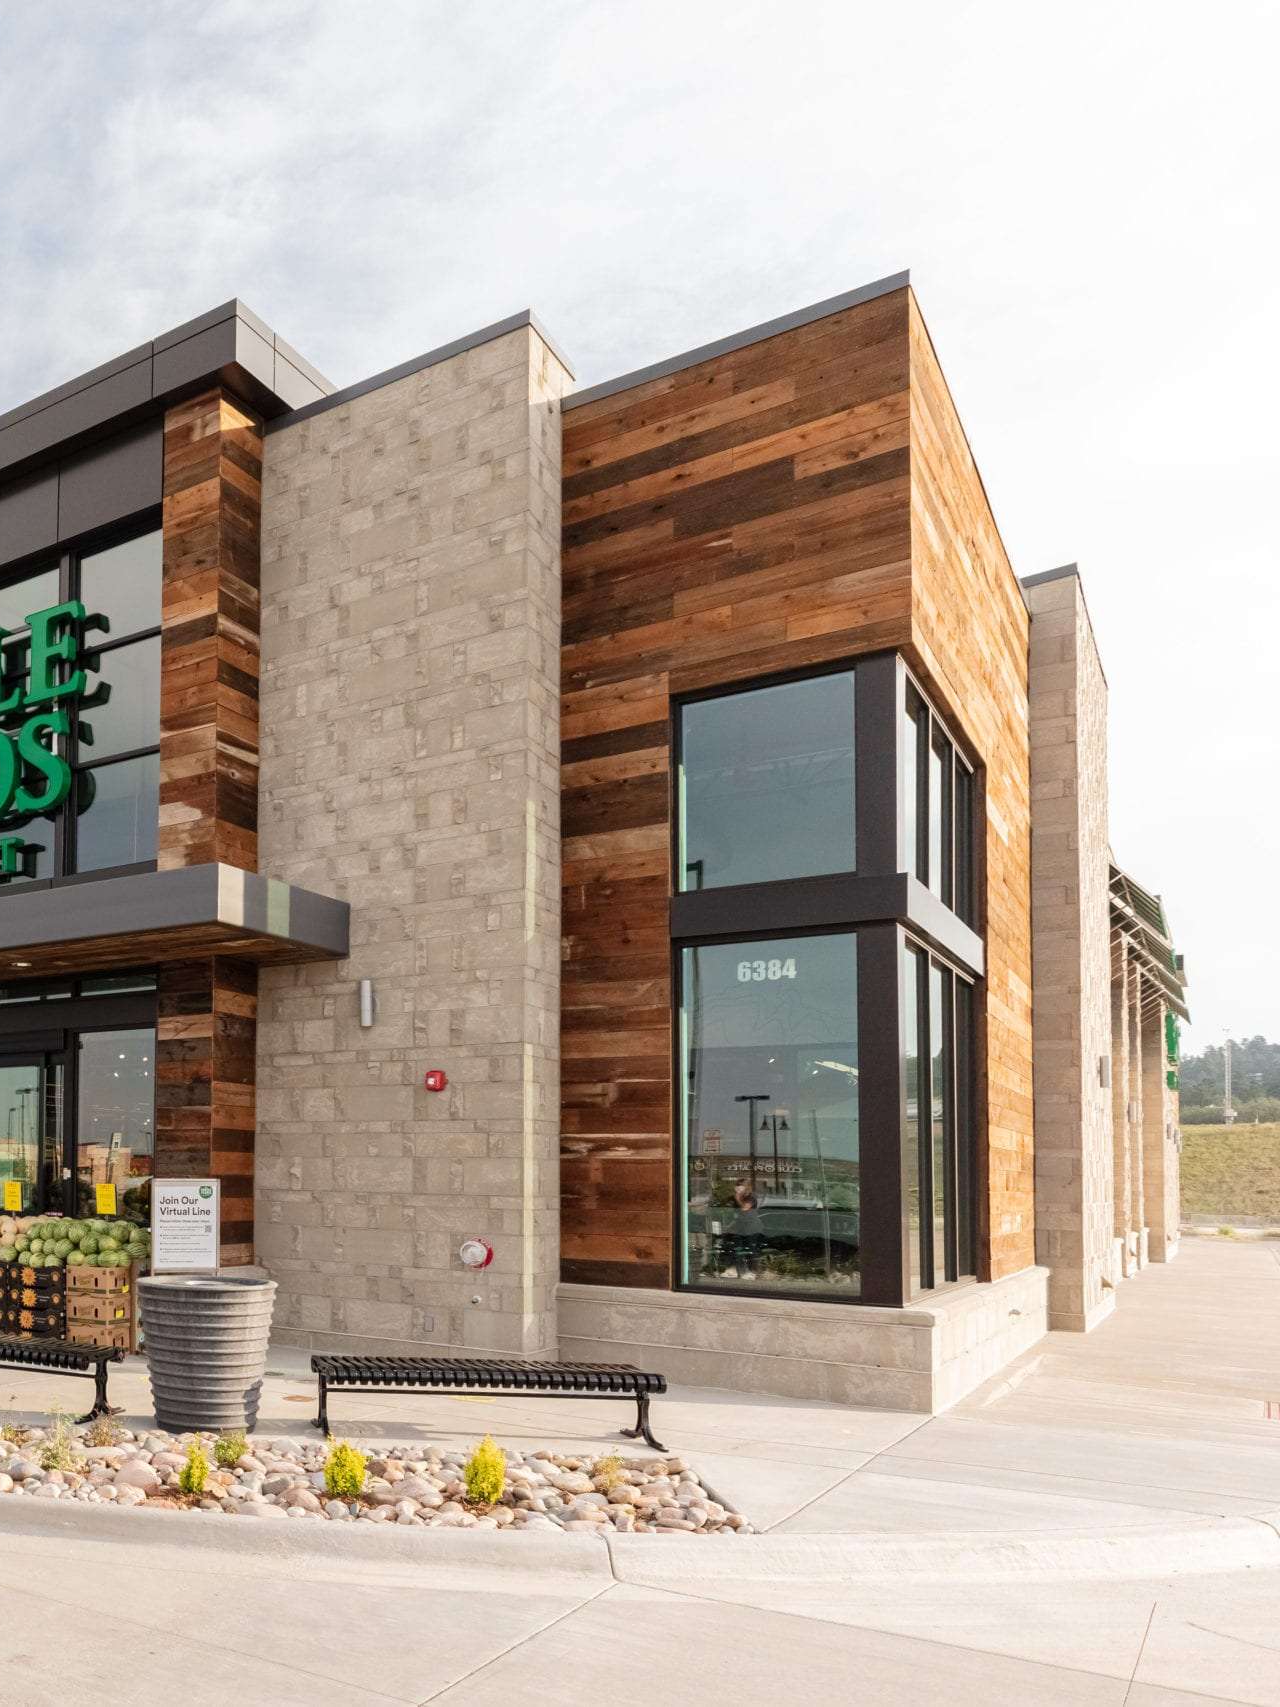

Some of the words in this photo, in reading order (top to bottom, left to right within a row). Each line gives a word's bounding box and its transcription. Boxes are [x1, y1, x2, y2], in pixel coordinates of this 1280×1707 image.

[737, 958, 797, 981] 6384
[160, 1196, 179, 1205] Join
[181, 1196, 199, 1205] Our
[160, 1207, 190, 1216] Virtual
[192, 1207, 211, 1216] Line
